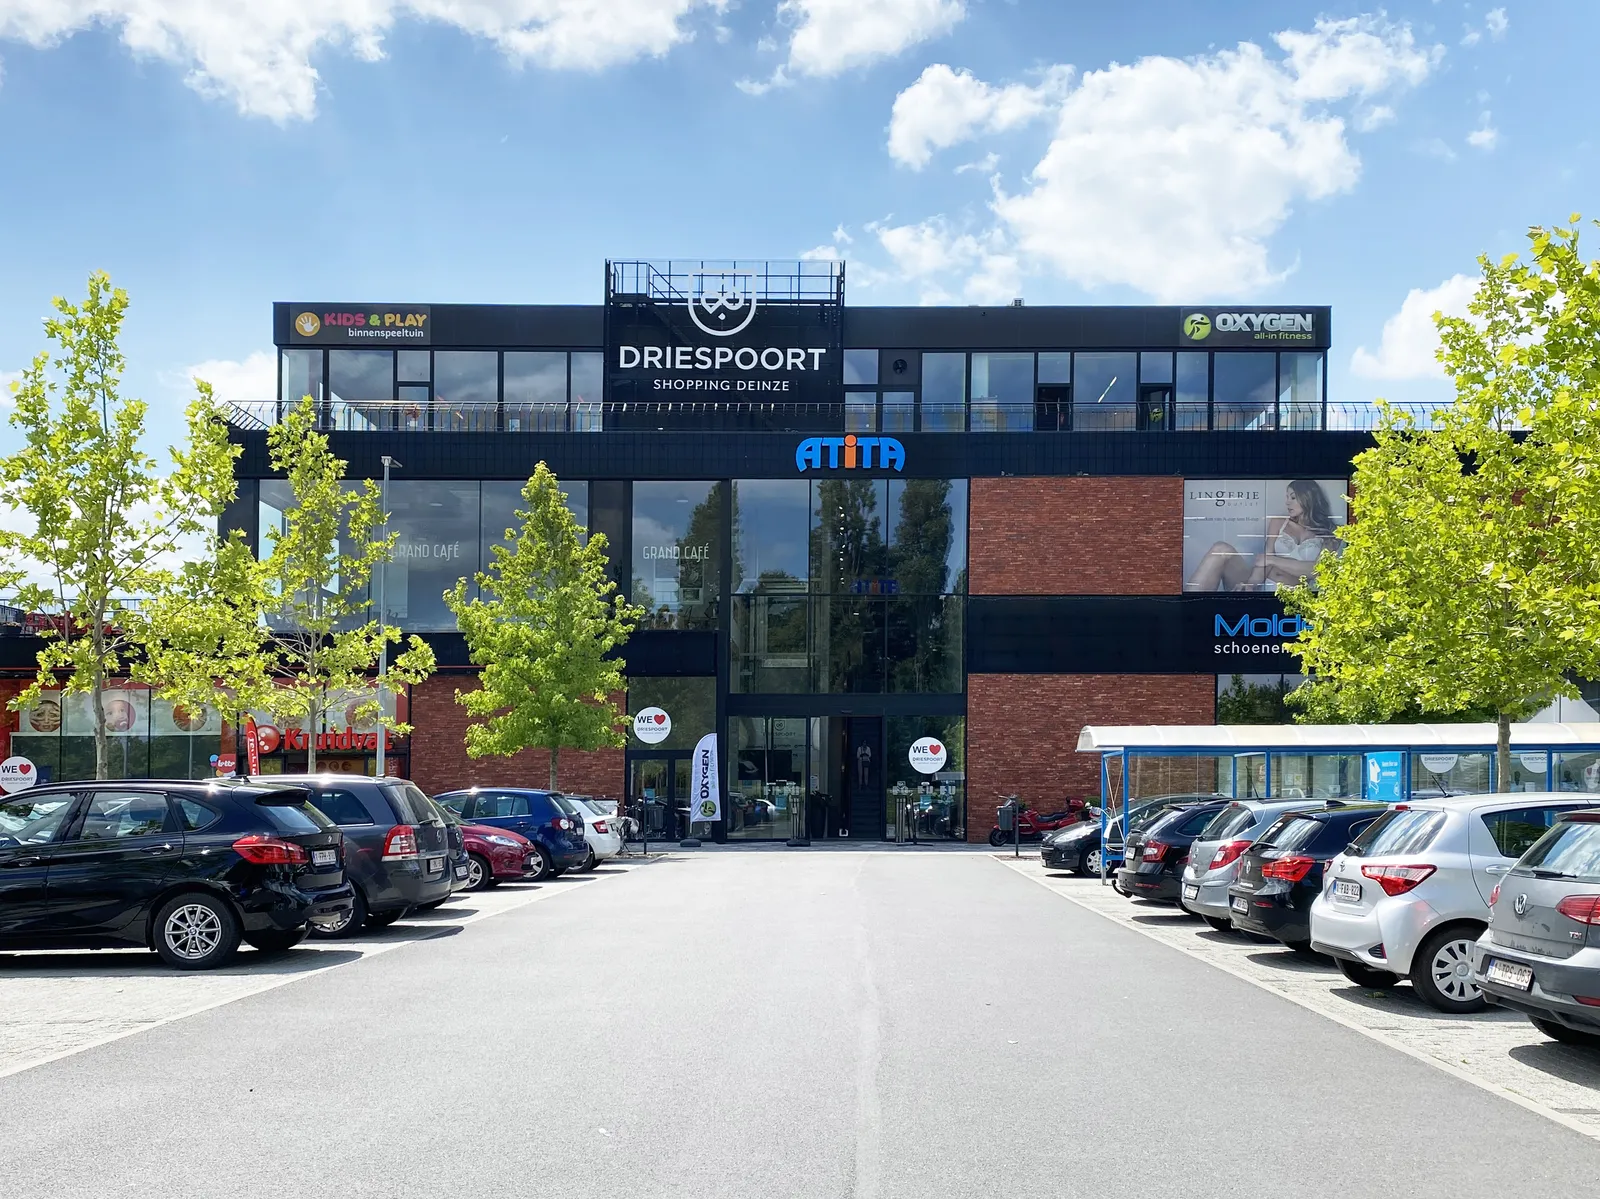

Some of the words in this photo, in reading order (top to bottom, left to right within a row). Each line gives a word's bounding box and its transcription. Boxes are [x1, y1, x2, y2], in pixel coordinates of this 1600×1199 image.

[324, 312, 366, 327] KIDS
[369, 314, 380, 326] &
[384, 313, 427, 327] PLAY
[1215, 313, 1313, 332] OXYGEN
[348, 328, 424, 339] binnenspeeltuin
[1254, 332, 1277, 340] all-in
[1279, 332, 1312, 340] fitness
[619, 345, 826, 371] DRIESPOORT
[653, 379, 730, 391] SHOPPING
[737, 380, 790, 391] DEINZE
[433, 541, 459, 561] CAFÉ
[642, 546, 680, 560] GRAND
[684, 542, 710, 562] CAFÉ
[637, 715, 653, 724] WE
[912, 745, 928, 754] WE
[1, 765, 18, 774] WE
[700, 749, 710, 799] OXYGEN
